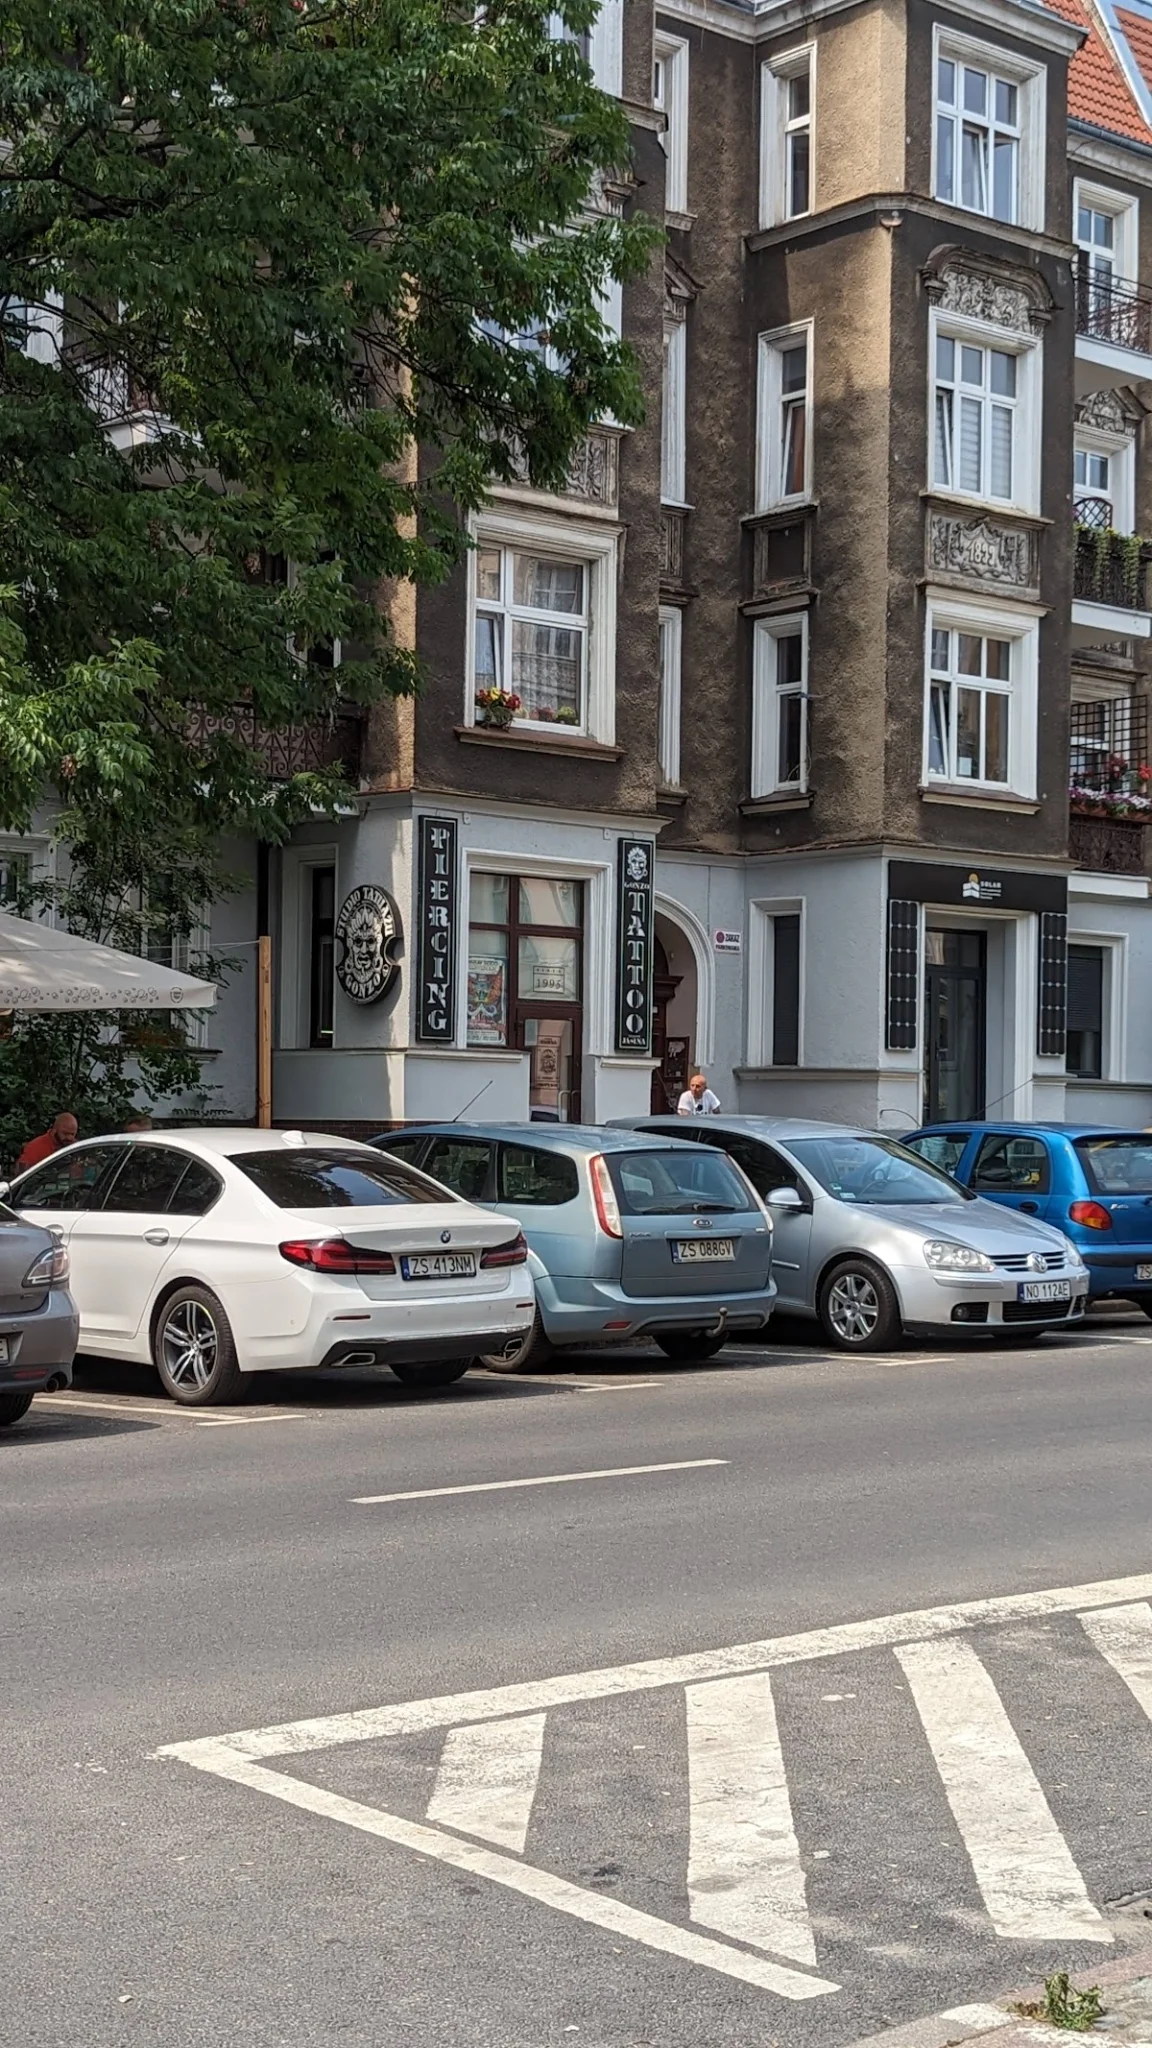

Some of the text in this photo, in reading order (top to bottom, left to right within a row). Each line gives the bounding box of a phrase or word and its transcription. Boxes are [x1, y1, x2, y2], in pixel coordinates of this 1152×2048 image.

[337, 890, 361, 938] STUDIO
[426, 827, 450, 1030] PIERCING
[626, 891, 645, 1033] TATTOO
[345, 973, 381, 999] GONZO
[536, 978, 562, 990] 1995
[680, 1240, 732, 1258] ZS 088GV
[411, 1256, 472, 1275] ZS 413NM
[1139, 1265, 1152, 1279] ZS
[1026, 1282, 1069, 1299] NO 112AE
